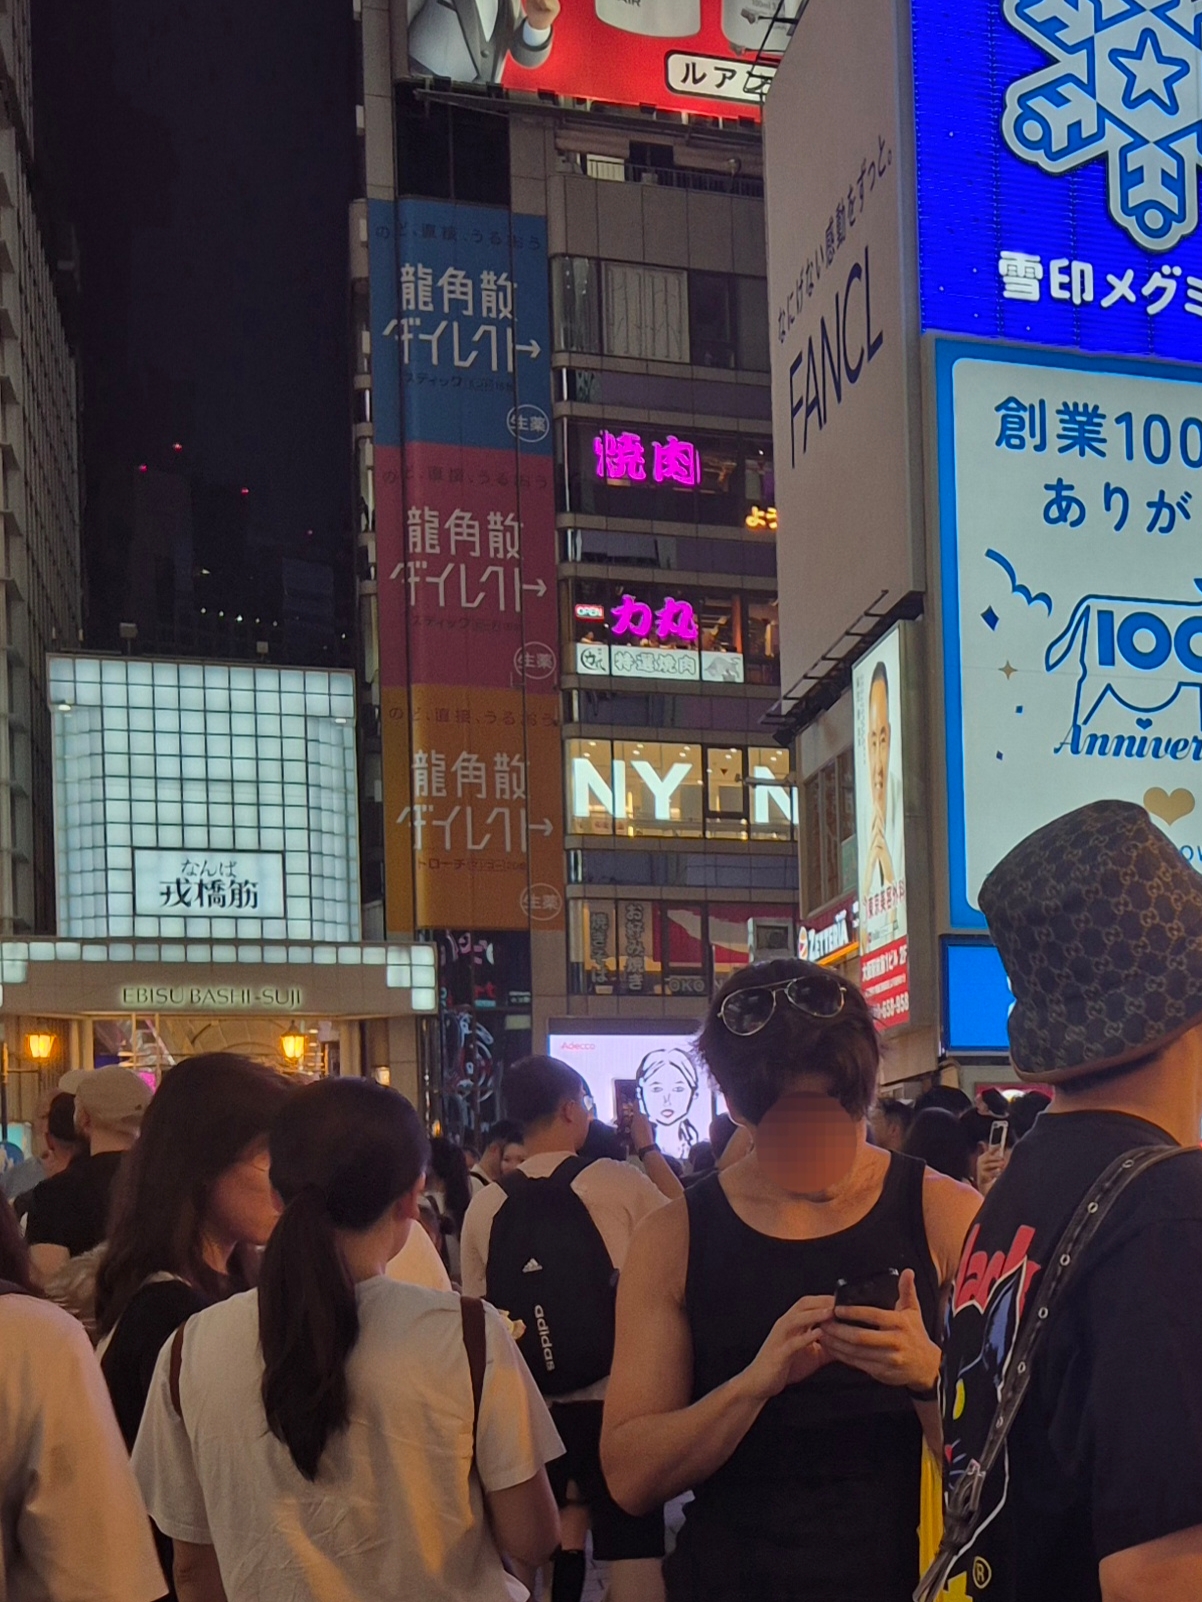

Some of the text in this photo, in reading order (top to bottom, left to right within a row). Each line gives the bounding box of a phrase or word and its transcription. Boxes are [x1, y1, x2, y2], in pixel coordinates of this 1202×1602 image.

[400, 263, 518, 321] 龍角散
[789, 245, 884, 469] FANCL
[594, 429, 701, 485] 焼肉
[407, 505, 523, 560] 龍角散
[611, 594, 698, 641] 力丸
[411, 749, 530, 800] 龍角散
[573, 757, 692, 820] NY
[159, 878, 259, 910] 戎橋筋
[180, 858, 236, 878] なんば
[534, 1304, 555, 1372] adidas
